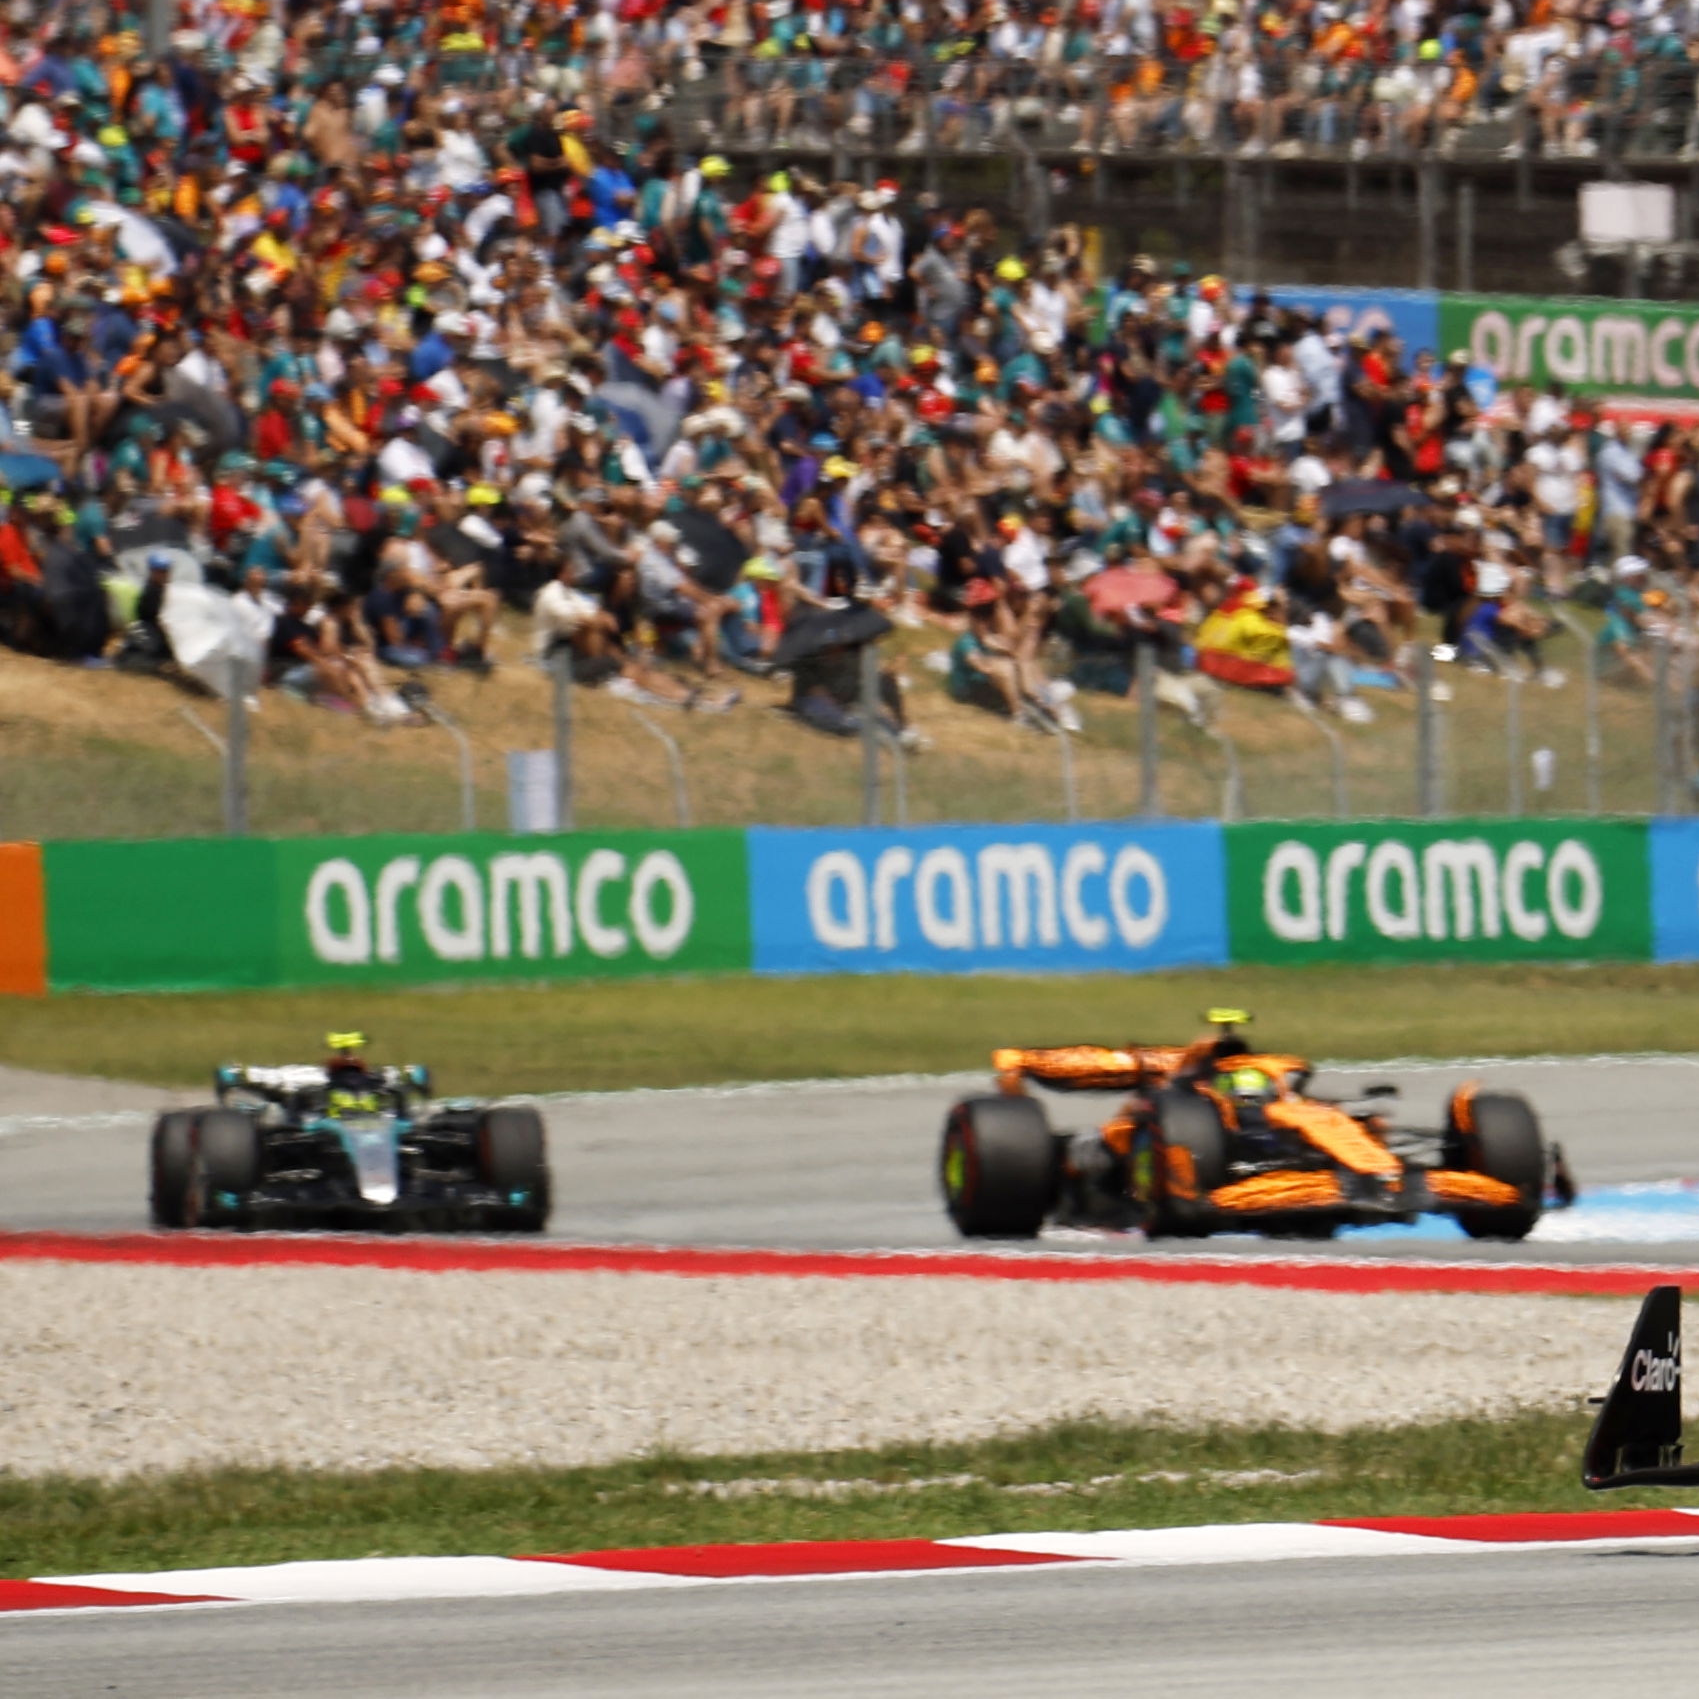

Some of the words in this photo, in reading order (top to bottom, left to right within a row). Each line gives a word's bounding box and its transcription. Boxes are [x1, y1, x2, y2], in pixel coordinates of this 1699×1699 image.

[304, 848, 695, 964] aramco
[806, 842, 1169, 950] aramco
[1262, 838, 1603, 942] aramco
[1631, 1349, 1677, 1391] Claro
